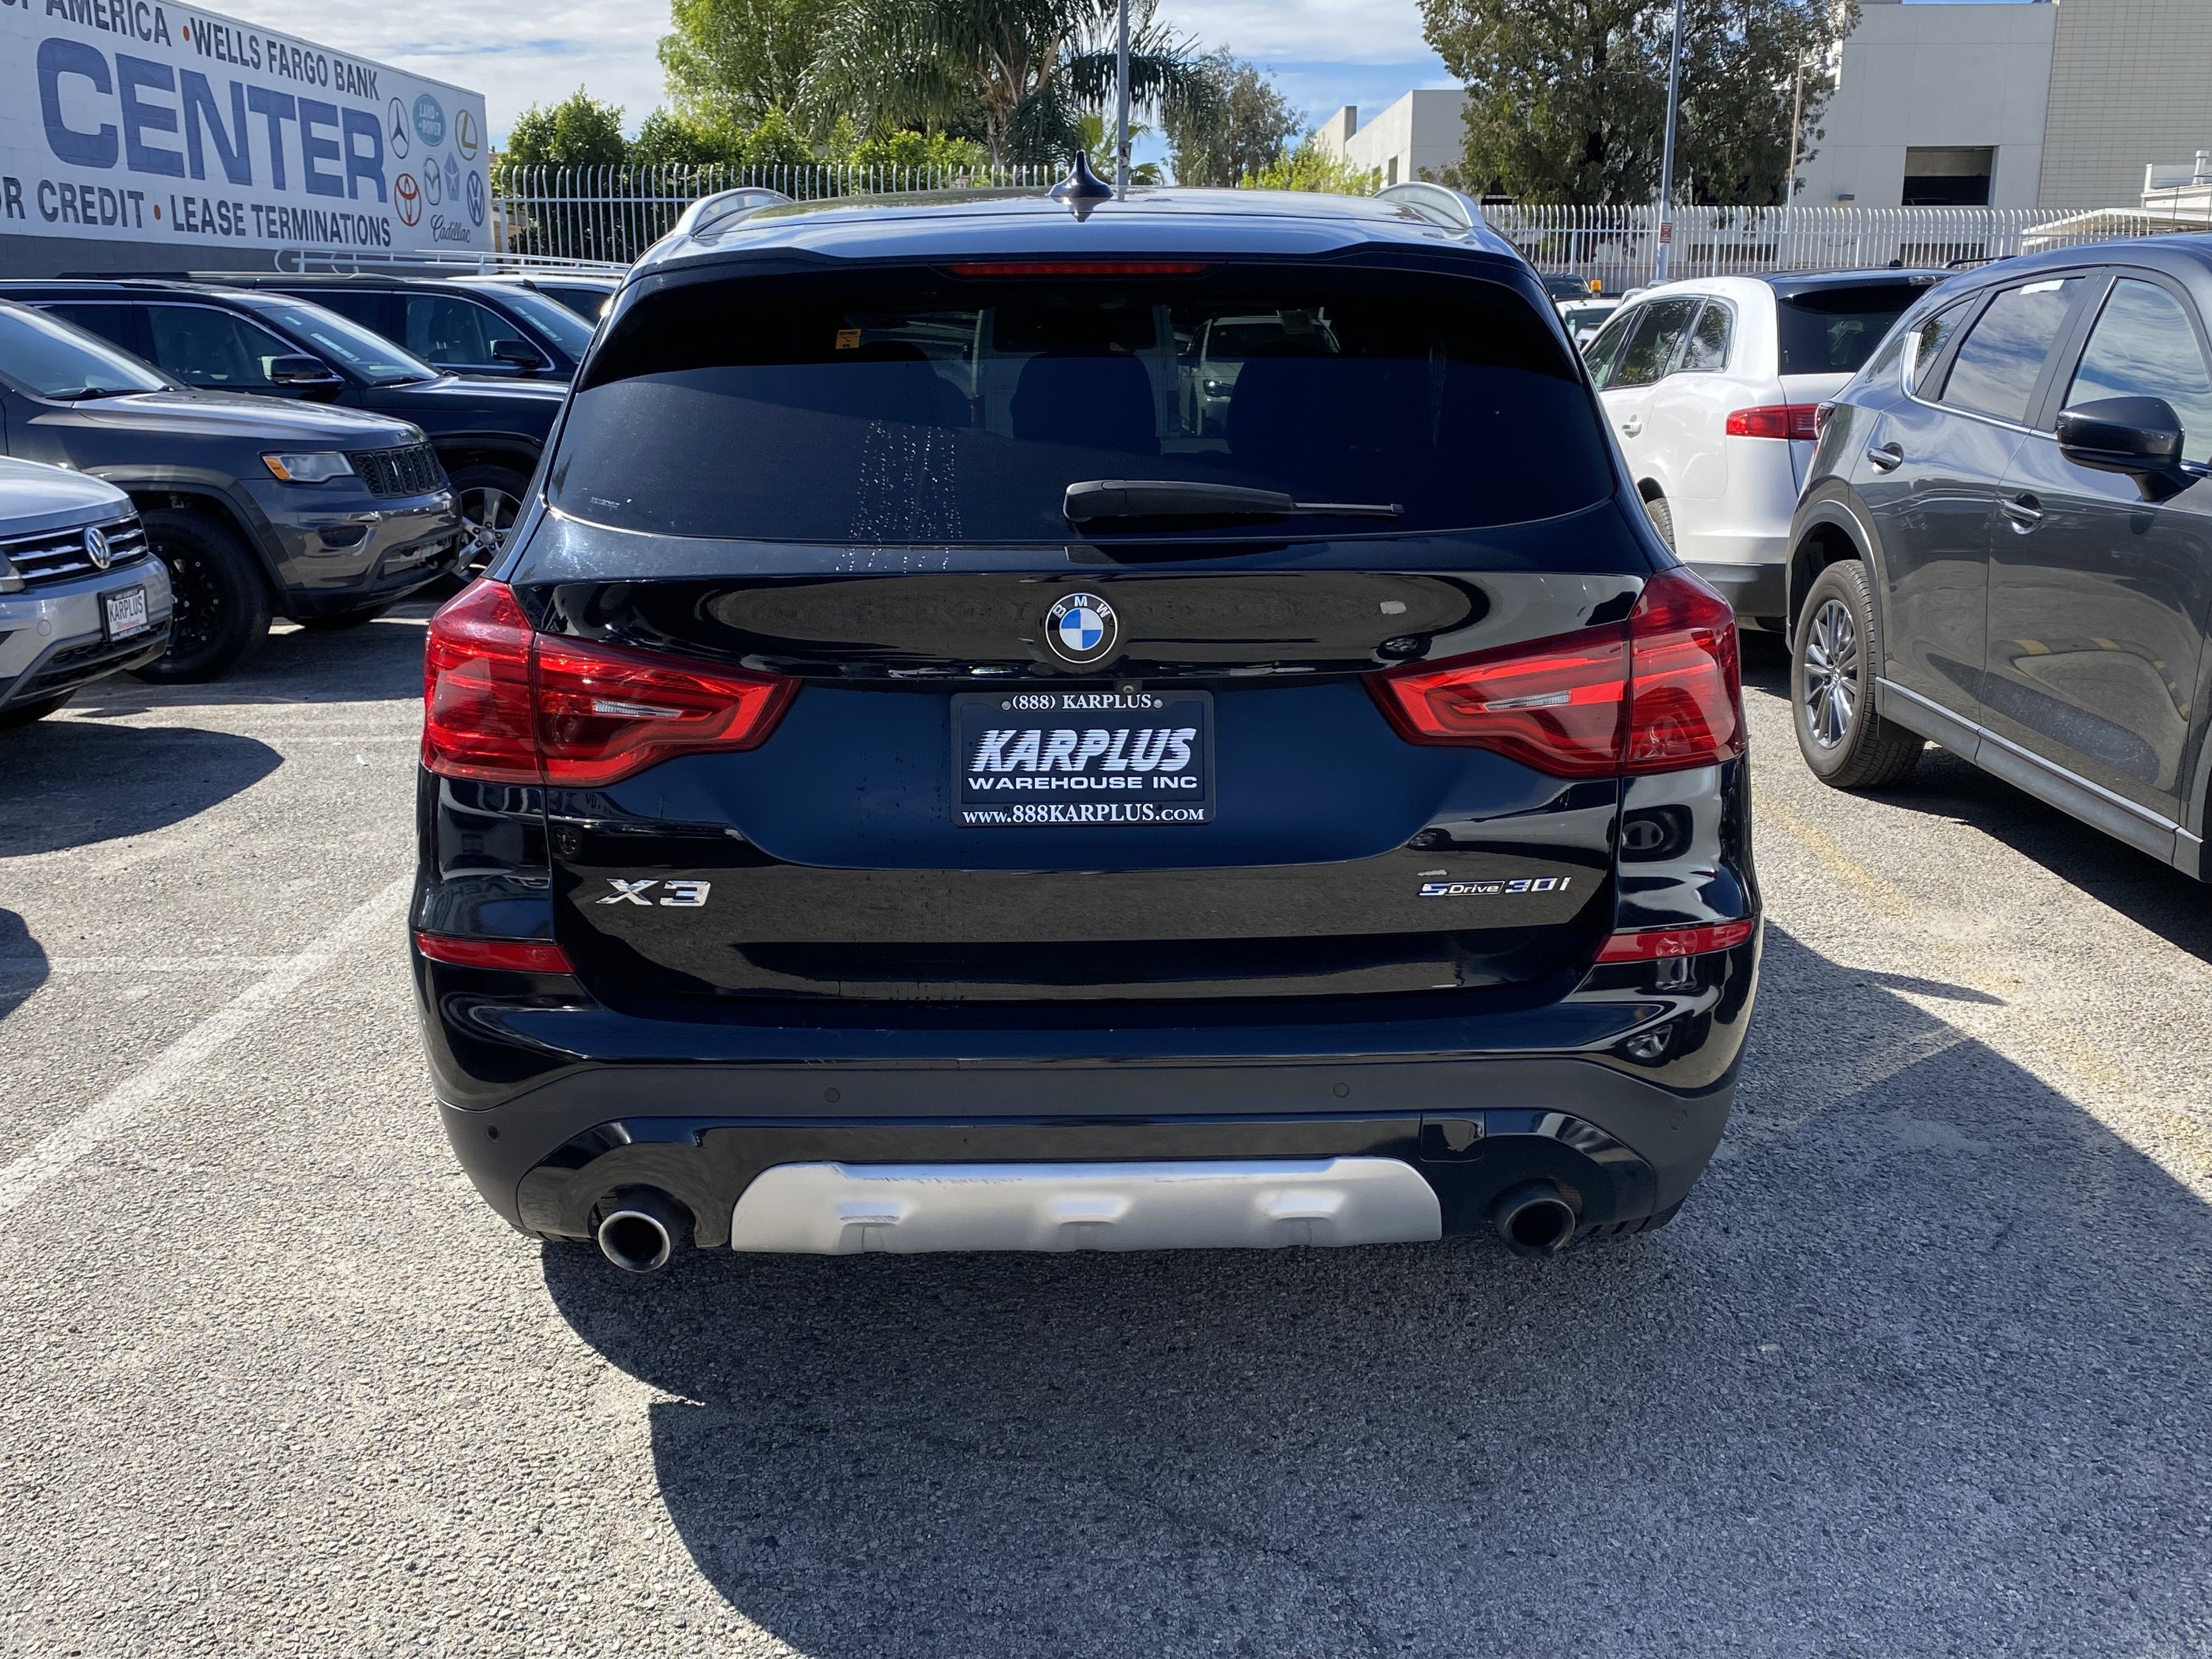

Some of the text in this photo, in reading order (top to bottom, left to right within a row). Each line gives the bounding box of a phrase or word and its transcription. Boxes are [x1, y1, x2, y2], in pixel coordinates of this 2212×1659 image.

[190, 17, 261, 70] WELLS
[267, 40, 328, 87] FARGO
[334, 60, 380, 100] BANK
[37, 37, 387, 203] CENTER
[419, 103, 435, 119] LAND
[422, 120, 441, 136] ROVER
[0, 177, 391, 247] R CREDIT LEASE TERMINATIONS
[431, 215, 471, 243] Cadillac
[109, 595, 143, 623] KARPLUS
[1053, 595, 1111, 619] BMW
[1012, 694, 1152, 710] (888) KARPLUS
[968, 727, 1197, 772] KARPLUS
[968, 776, 1198, 789] WAREHOUSE INC
[596, 878, 710, 907] X3
